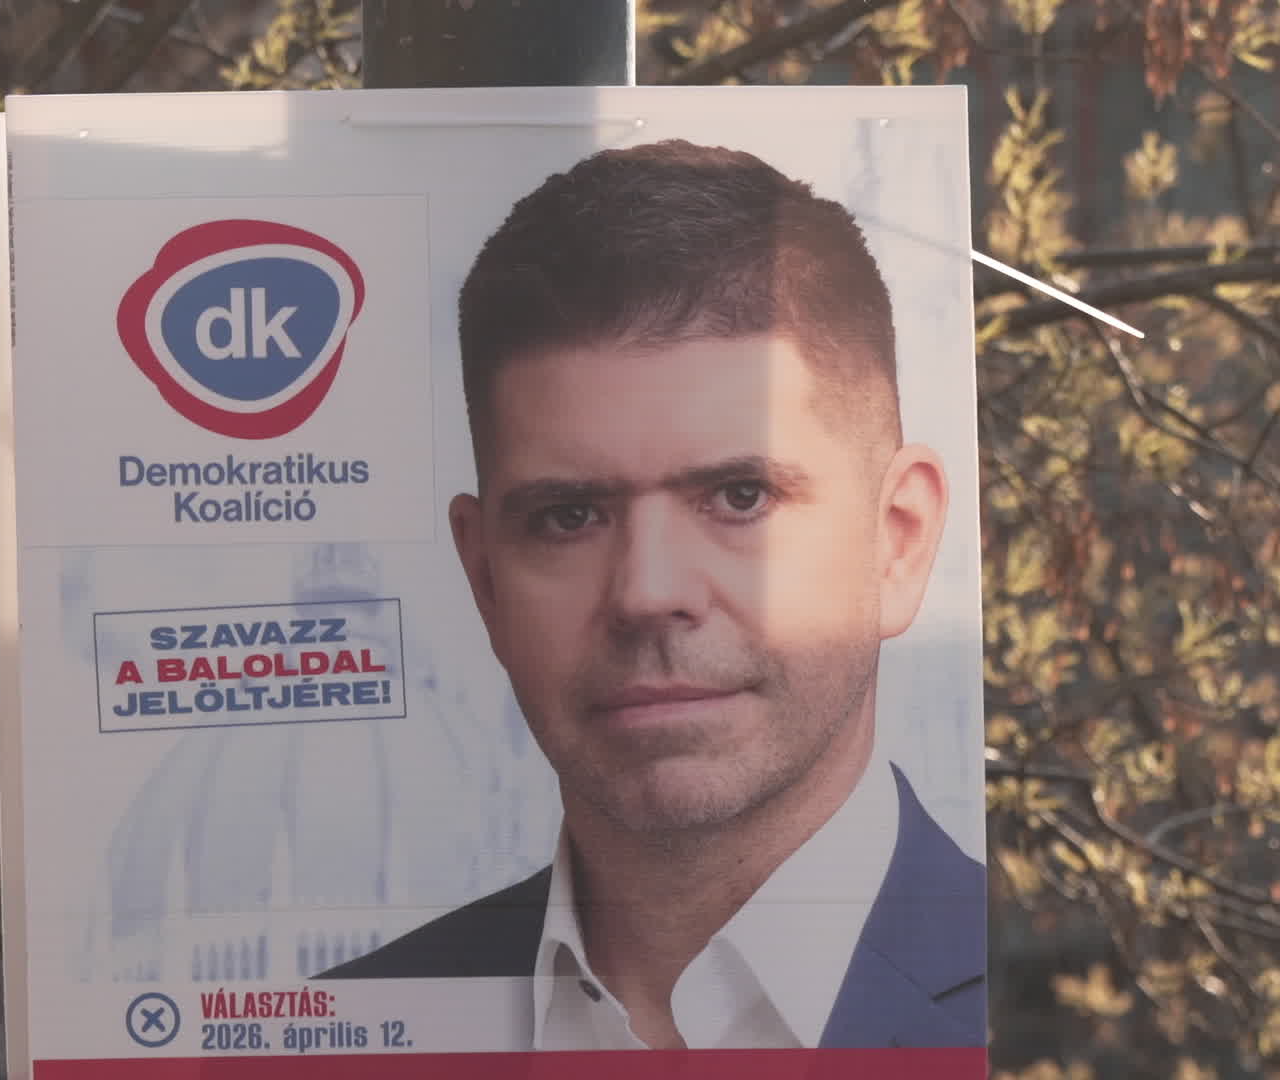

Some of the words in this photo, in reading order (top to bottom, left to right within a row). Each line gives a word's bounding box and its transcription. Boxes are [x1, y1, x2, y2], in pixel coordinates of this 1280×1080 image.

[195, 287, 303, 361] dk
[119, 455, 370, 488] Demokratikus
[174, 489, 317, 523] Koalíció
[150, 618, 348, 650] SZAVAZZ
[115, 660, 144, 686] A
[156, 648, 387, 684] BALOLDAL
[112, 679, 393, 718] JELÖLTJÉRE!
[201, 988, 337, 1019] VÁLASZTÁS:
[201, 1023, 272, 1050] 2026.
[283, 1020, 369, 1053] április
[381, 1020, 415, 1048] 12.
